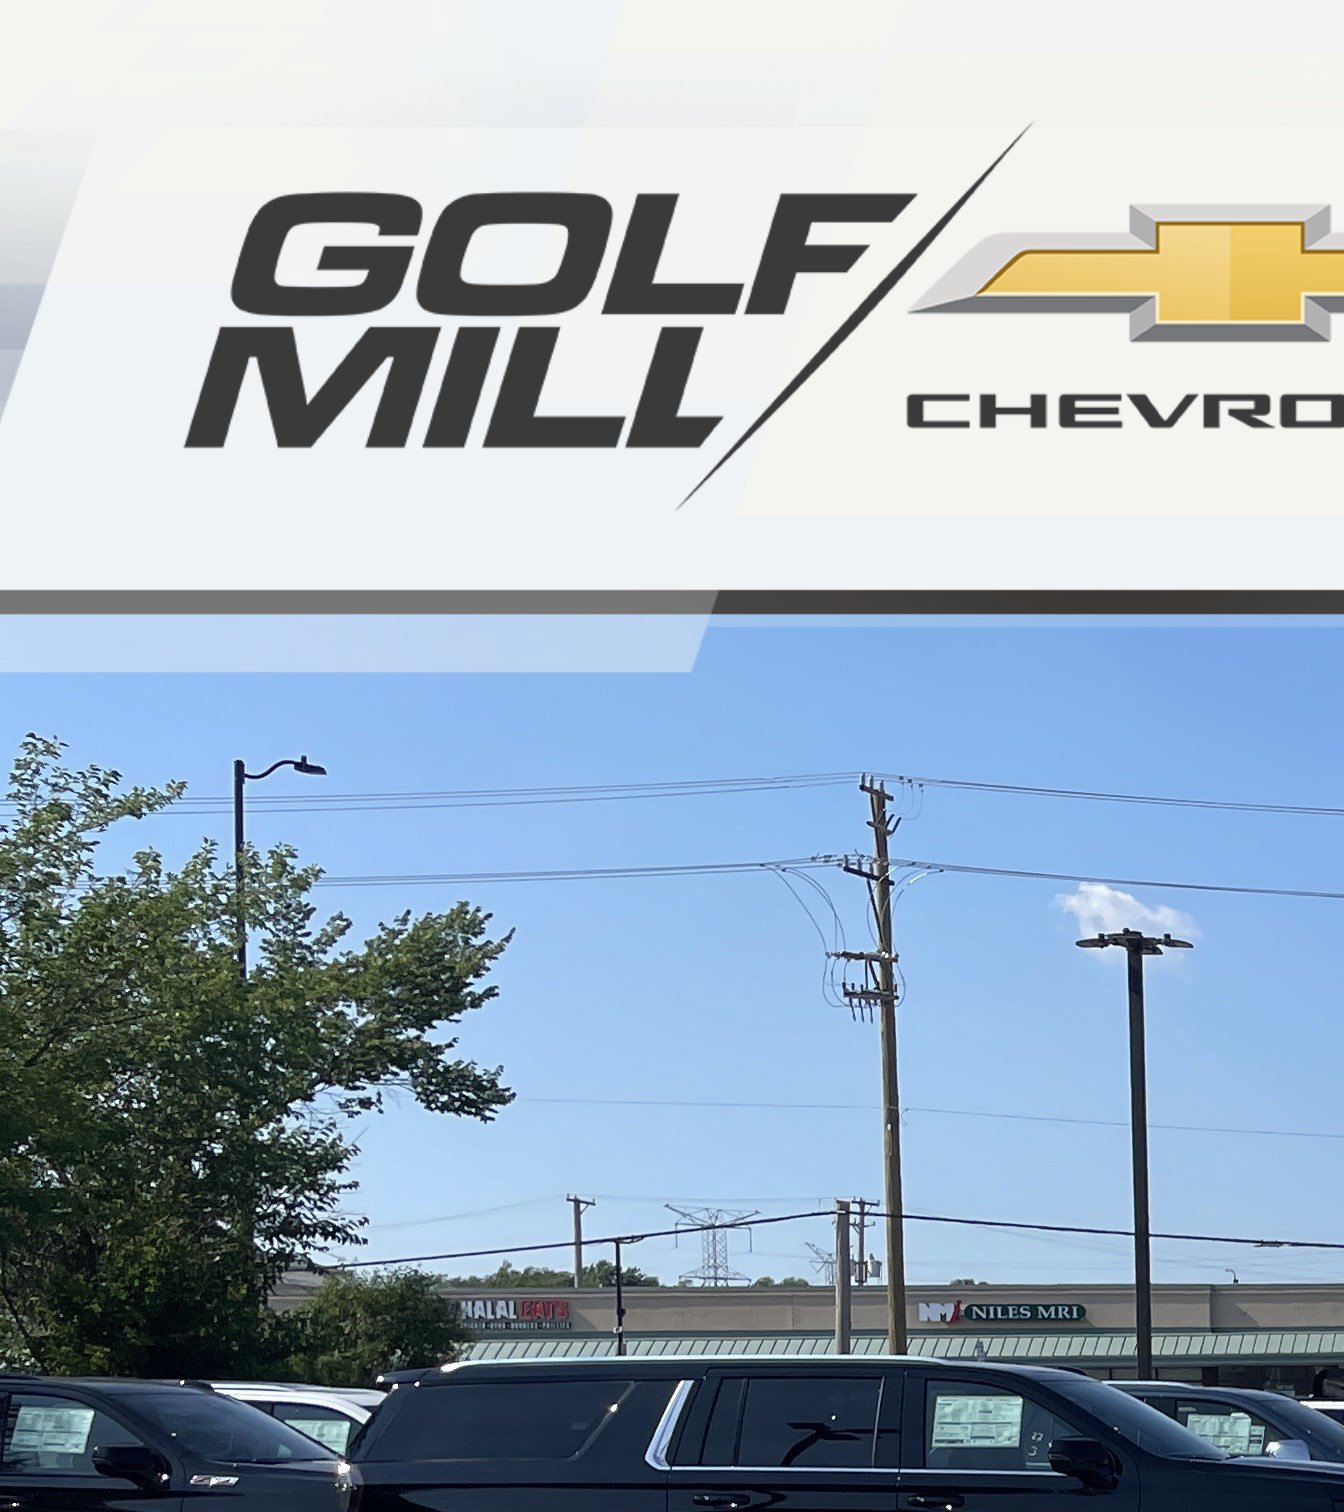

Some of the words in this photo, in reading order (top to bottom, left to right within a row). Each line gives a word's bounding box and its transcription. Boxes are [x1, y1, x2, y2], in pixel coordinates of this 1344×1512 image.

[460, 1300, 517, 1320] HALAL
[520, 1300, 570, 1320] EATS
[972, 1305, 1032, 1320] NILES
[1037, 1305, 1080, 1320] MRI
